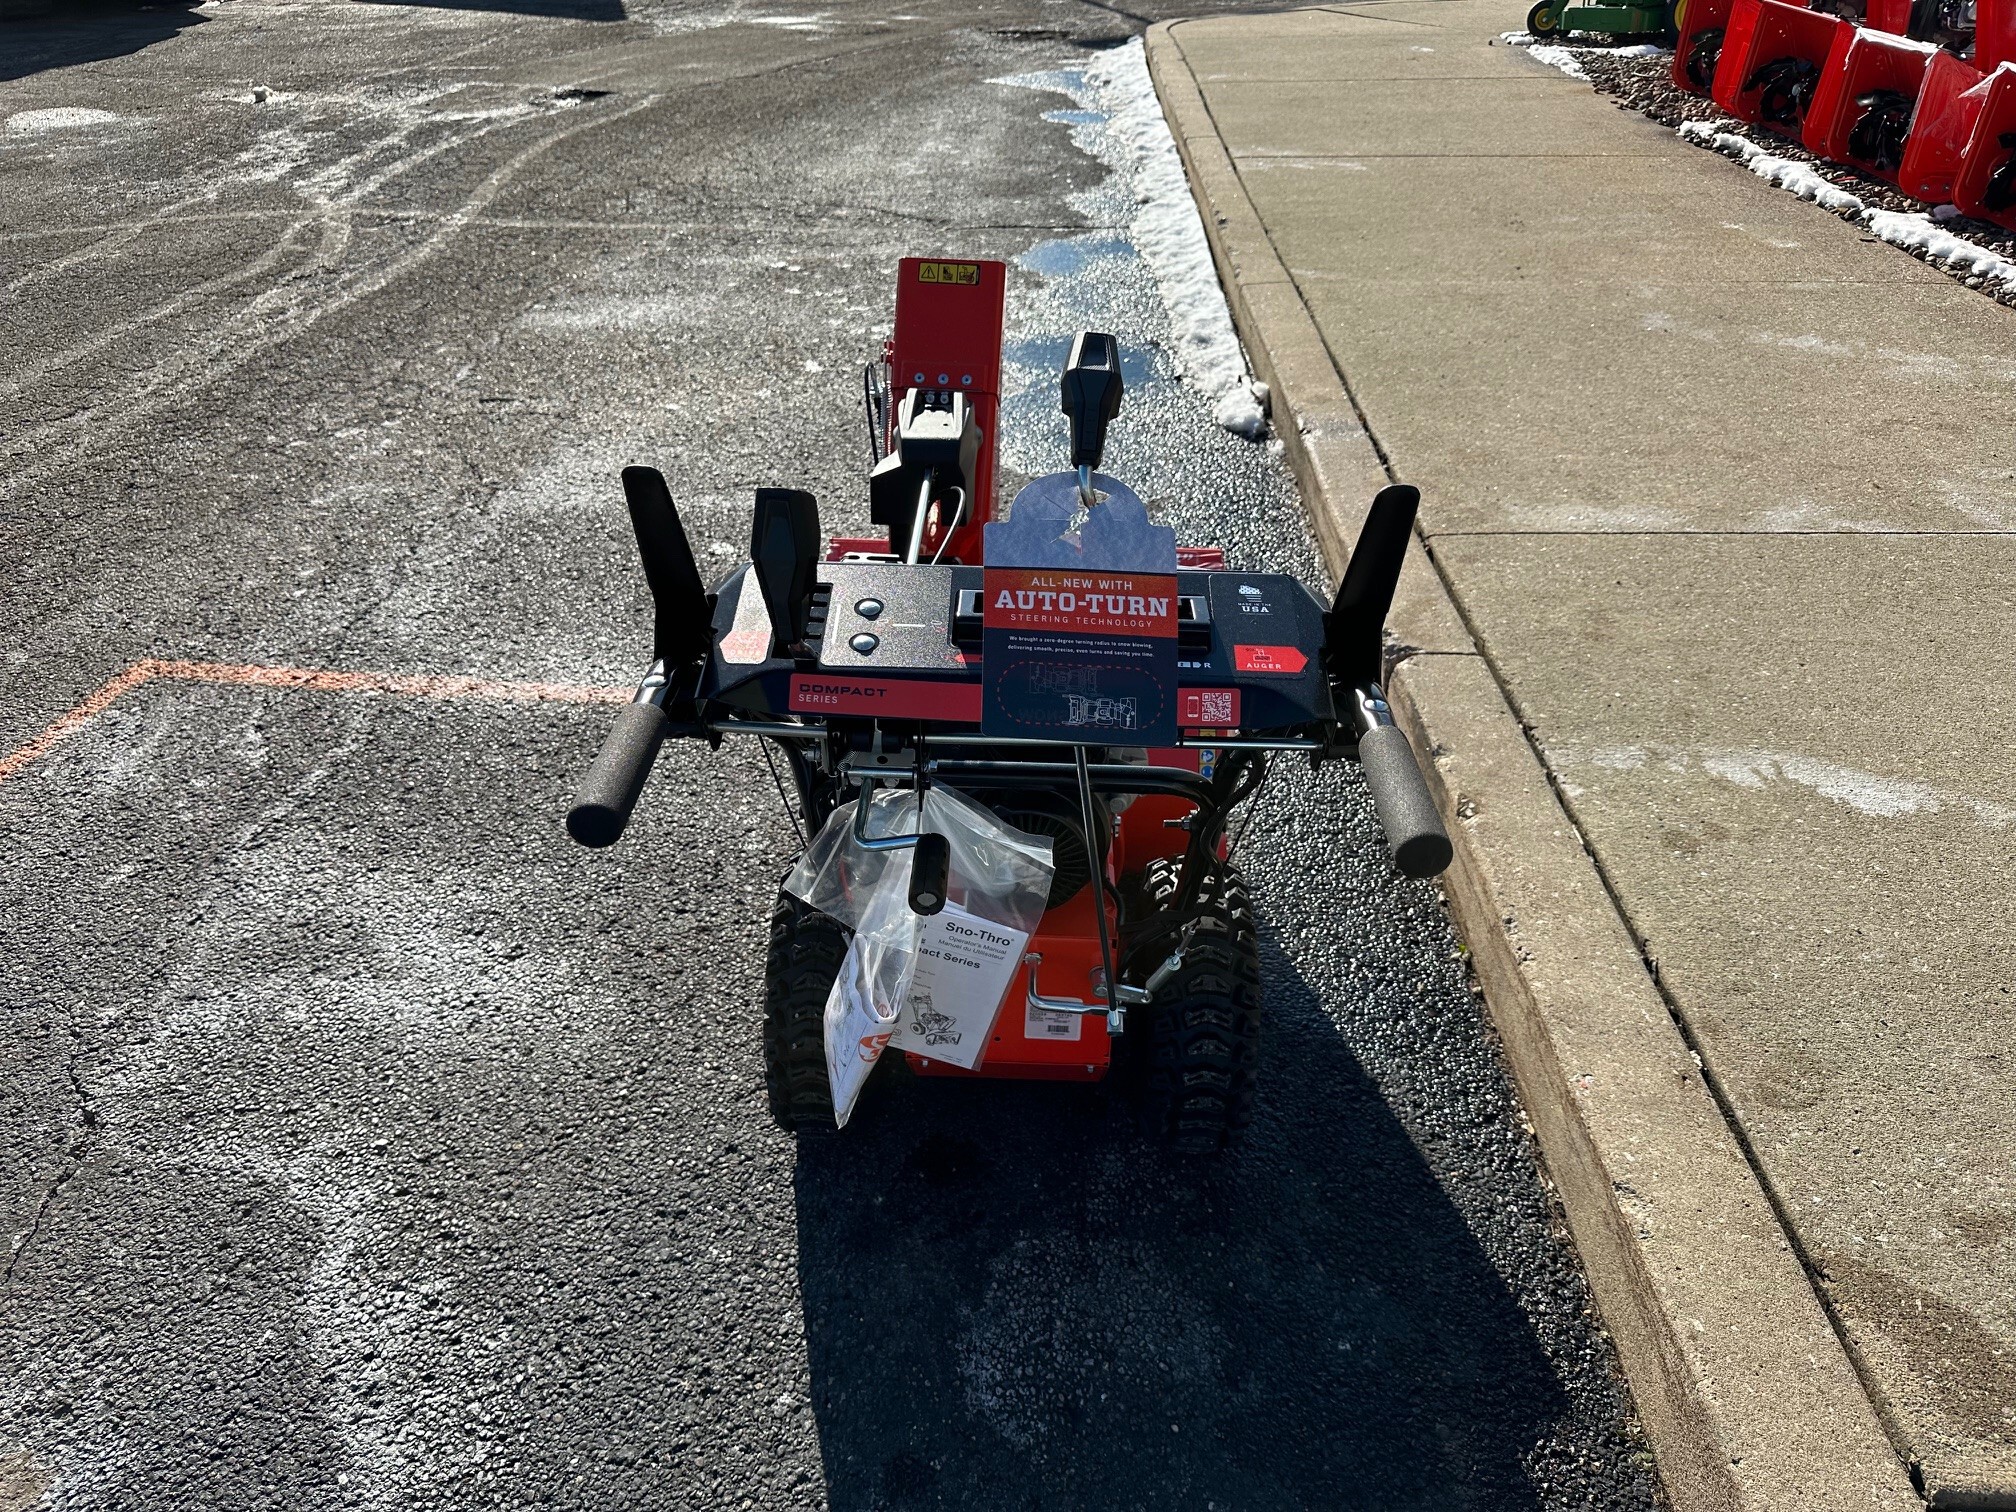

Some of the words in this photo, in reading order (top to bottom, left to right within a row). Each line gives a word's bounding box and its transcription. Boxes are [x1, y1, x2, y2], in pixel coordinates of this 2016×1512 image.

[1031, 576, 1093, 589] ALL-NEW
[1098, 579, 1133, 591] WITH
[995, 589, 1168, 617] AUTO-TURN
[1010, 613, 1069, 624] STEERING
[1076, 616, 1153, 628] TECHNOLOGY
[1246, 662, 1282, 670] AUGER
[799, 683, 888, 698] COMPACT
[798, 693, 838, 704] SERIES
[938, 938, 963, 950] Manuel
[973, 948, 1006, 960] Utilisateur
[948, 935, 982, 948] Operator's
[982, 944, 1008, 955] Manual
[943, 952, 981, 969] Series
